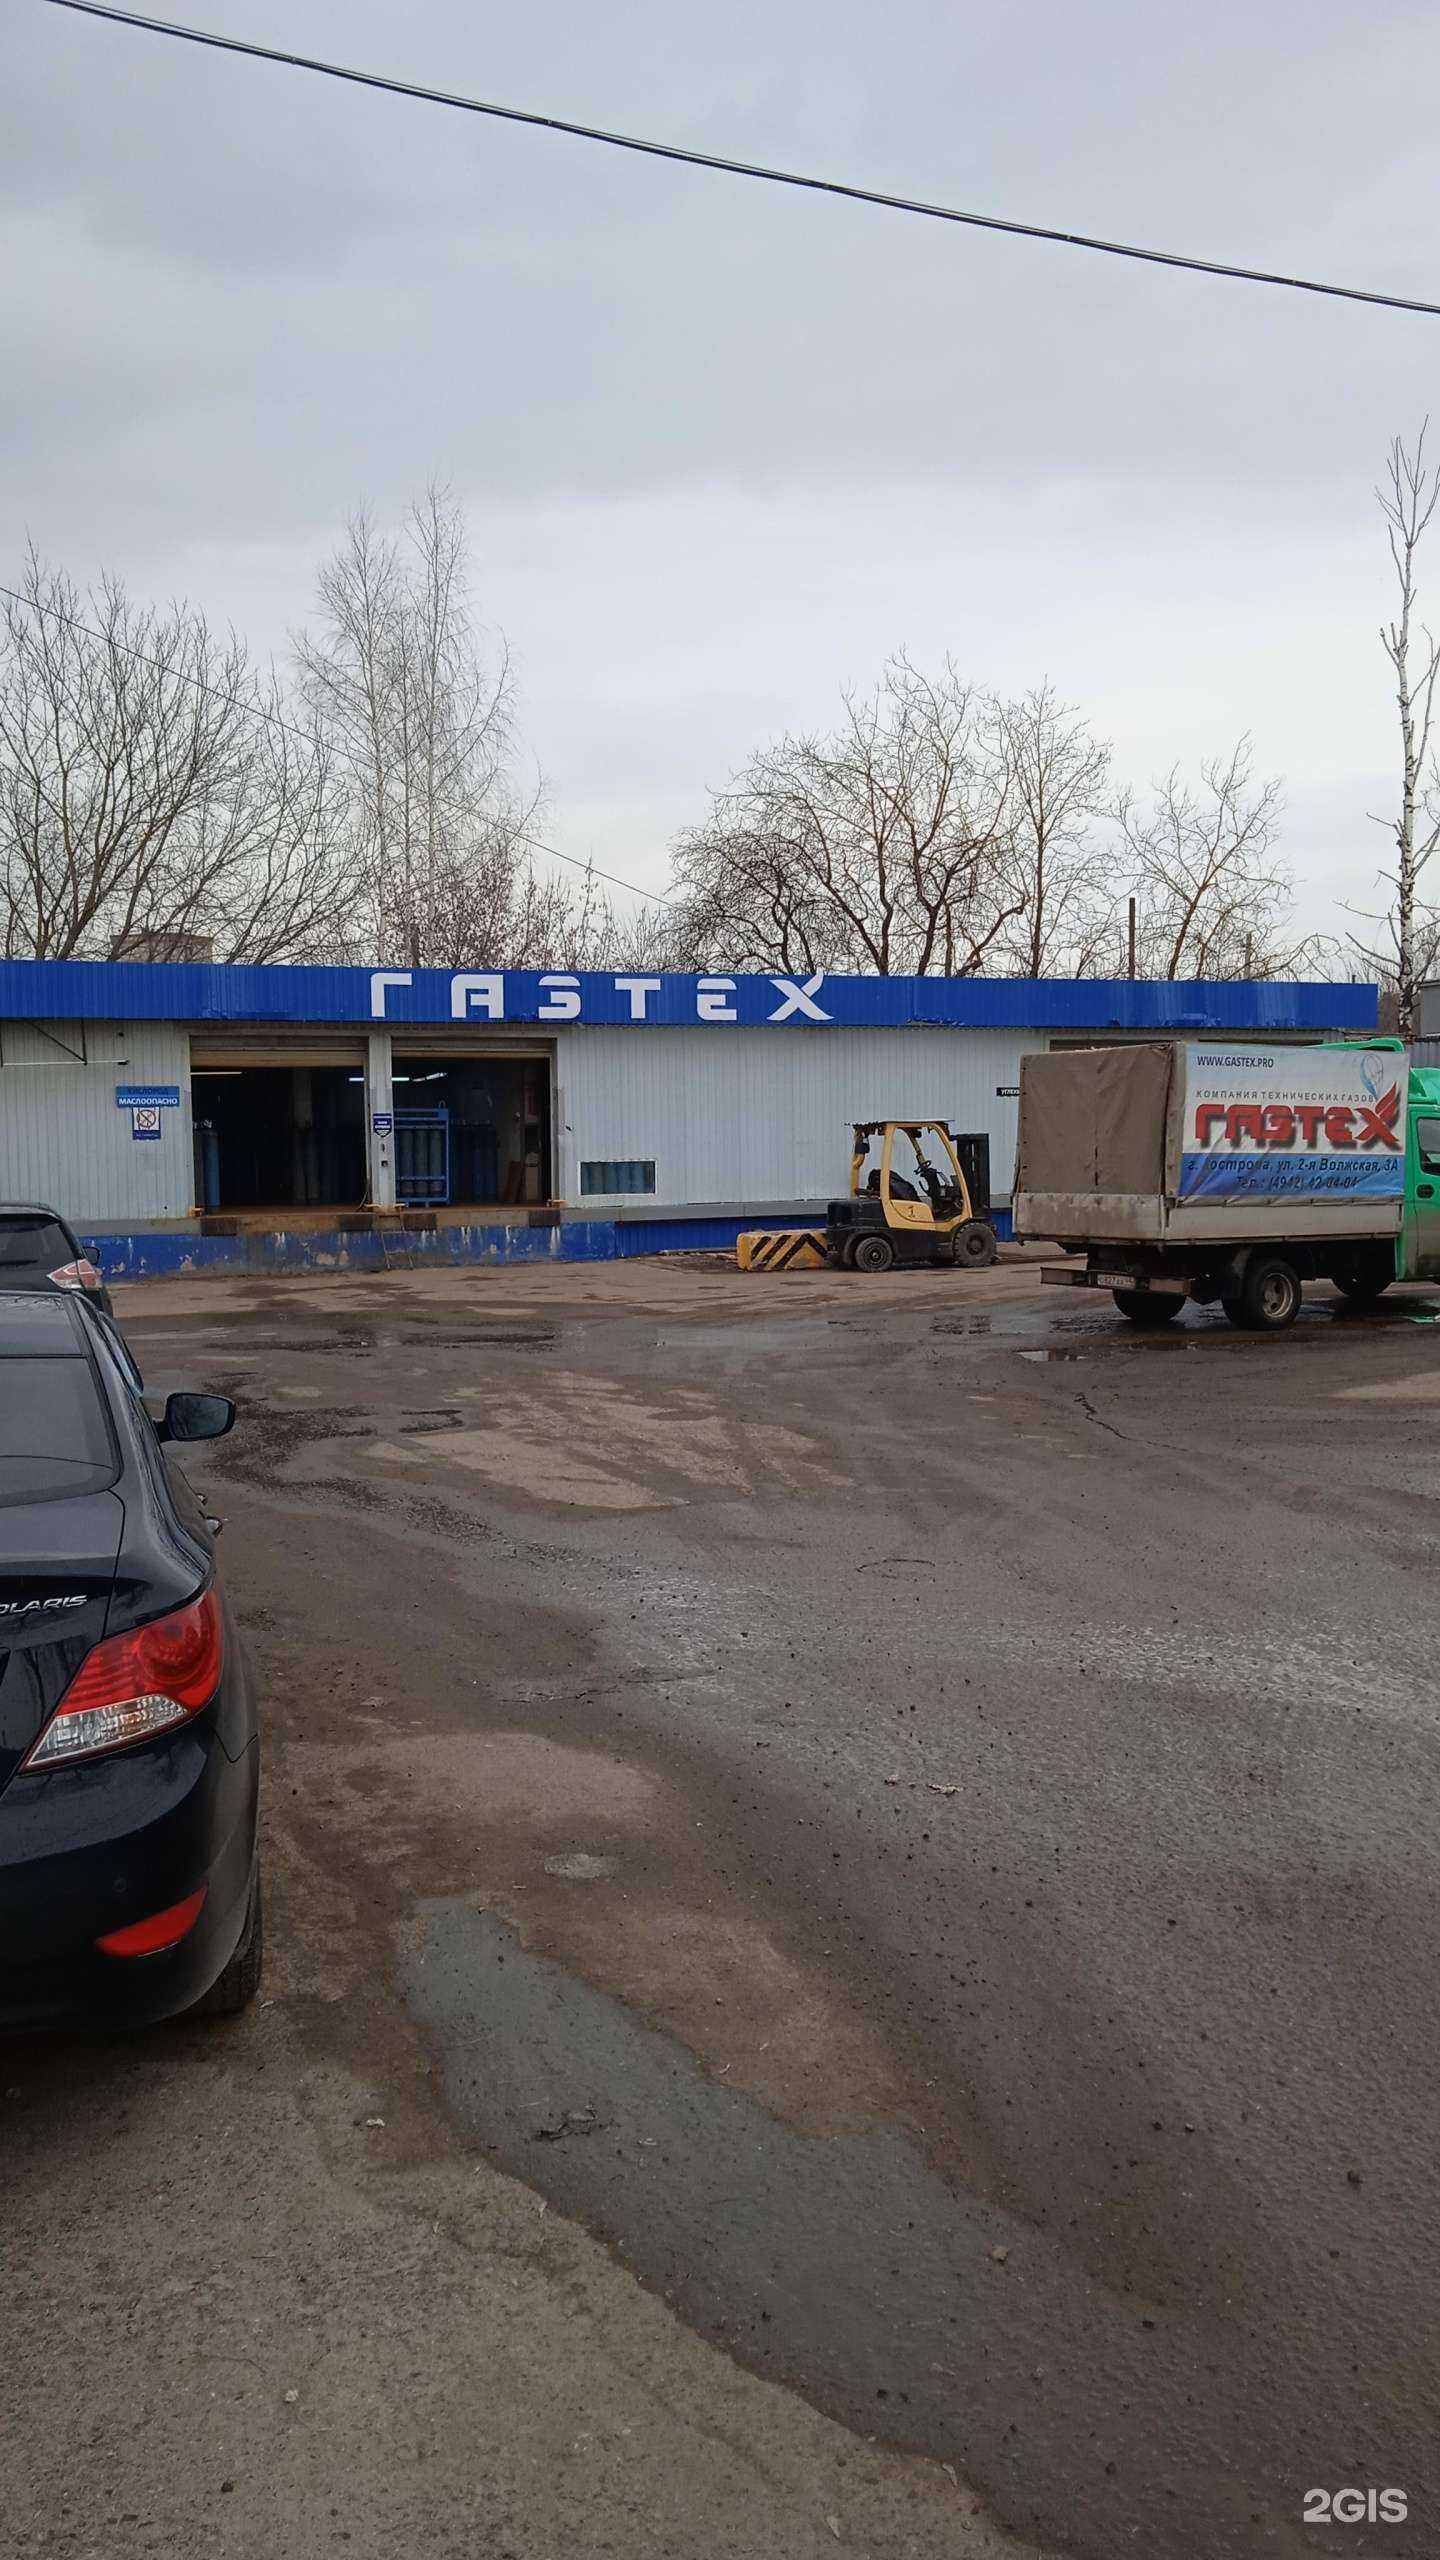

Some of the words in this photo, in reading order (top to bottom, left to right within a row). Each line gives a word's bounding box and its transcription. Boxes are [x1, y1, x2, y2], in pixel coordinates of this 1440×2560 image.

[1197, 1055, 1275, 1069] WWW.GASTEX.PRO
[1196, 1089, 1258, 1099] КОМПАНИЯ
[1261, 1091, 1338, 1101] ТЕХНИЧЕСКИХ
[1341, 1093, 1375, 1103] ГАЗОВ
[1208, 1158, 1274, 1172] остроа,
[1276, 1160, 1294, 1172] ул.
[1298, 1158, 1317, 1171] 2-я
[1320, 1158, 1381, 1172] Волжская,
[1384, 1159, 1398, 1171] 3А
